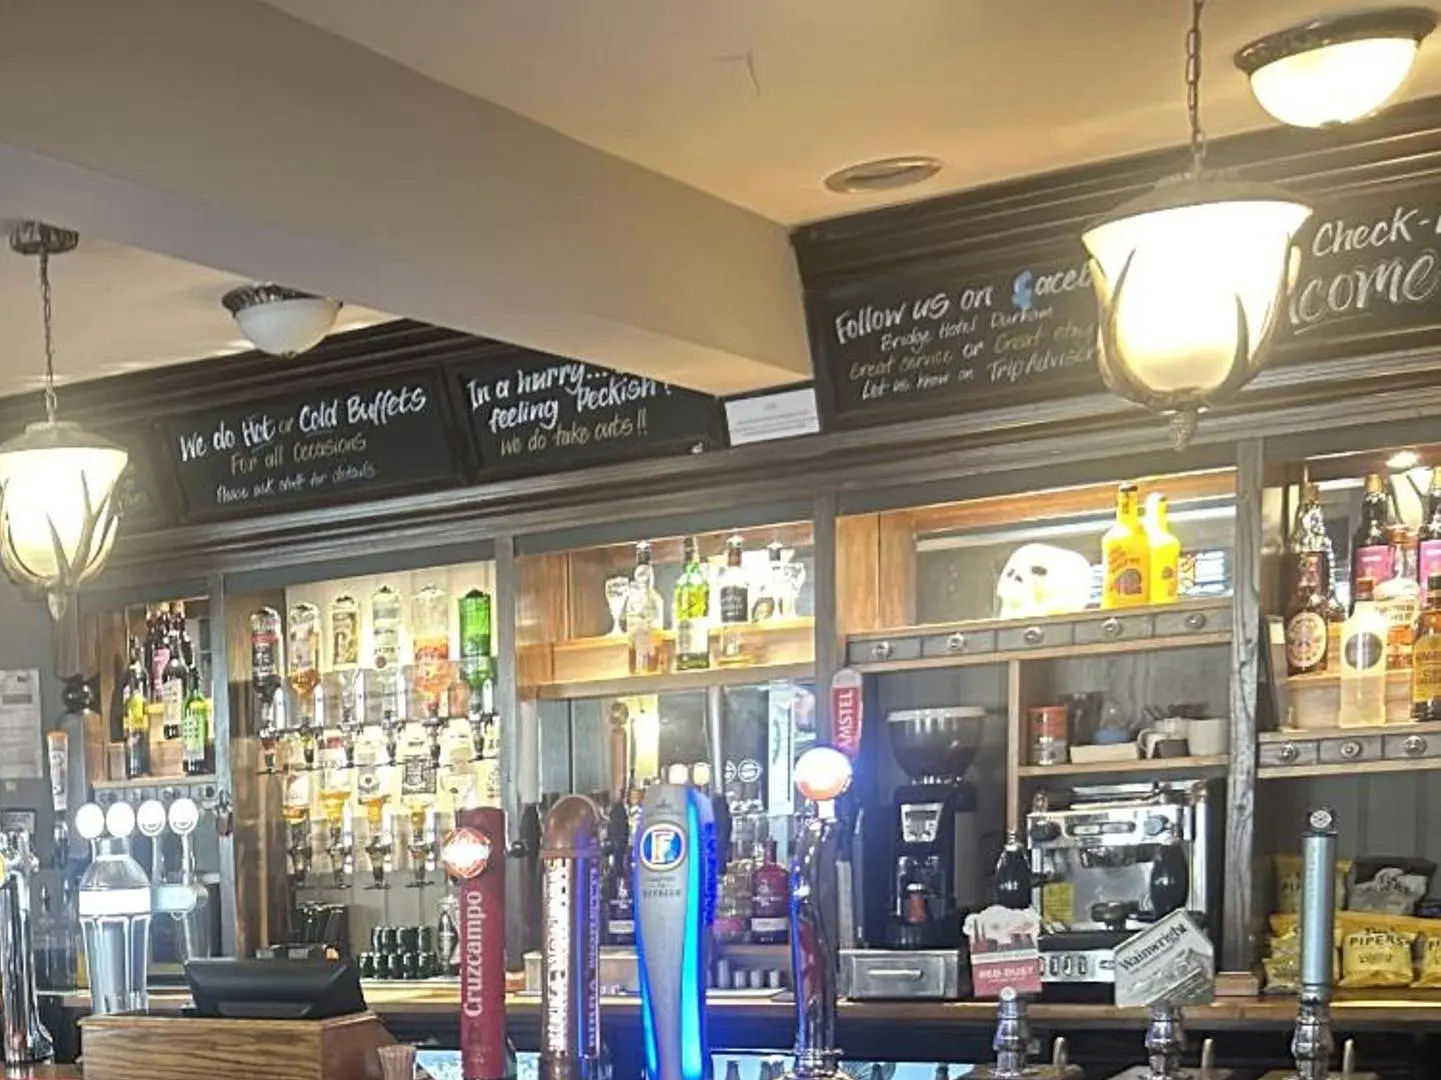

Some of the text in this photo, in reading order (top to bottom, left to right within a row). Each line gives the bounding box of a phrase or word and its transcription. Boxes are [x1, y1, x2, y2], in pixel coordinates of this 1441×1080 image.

[835, 303, 906, 345] Follow
[913, 293, 950, 321] us
[961, 286, 994, 310] on
[881, 306, 1053, 354] Bridge Hotel Durham
[850, 355, 894, 381] Great
[963, 340, 985, 358] or
[994, 325, 1043, 355] Great
[467, 379, 491, 411] In
[496, 379, 511, 400] a
[862, 382, 892, 401] Let
[179, 385, 427, 462] We do Hot or Cold Buffets
[488, 400, 559, 434] feeling
[501, 437, 522, 457] we
[528, 427, 548, 450] do
[554, 420, 590, 447] take
[231, 451, 258, 477] For
[265, 444, 284, 468] all
[463, 890, 487, 1018] Cruzcampo
[1118, 922, 1189, 971] Wainwright
[1350, 934, 1406, 947] PIPERS
